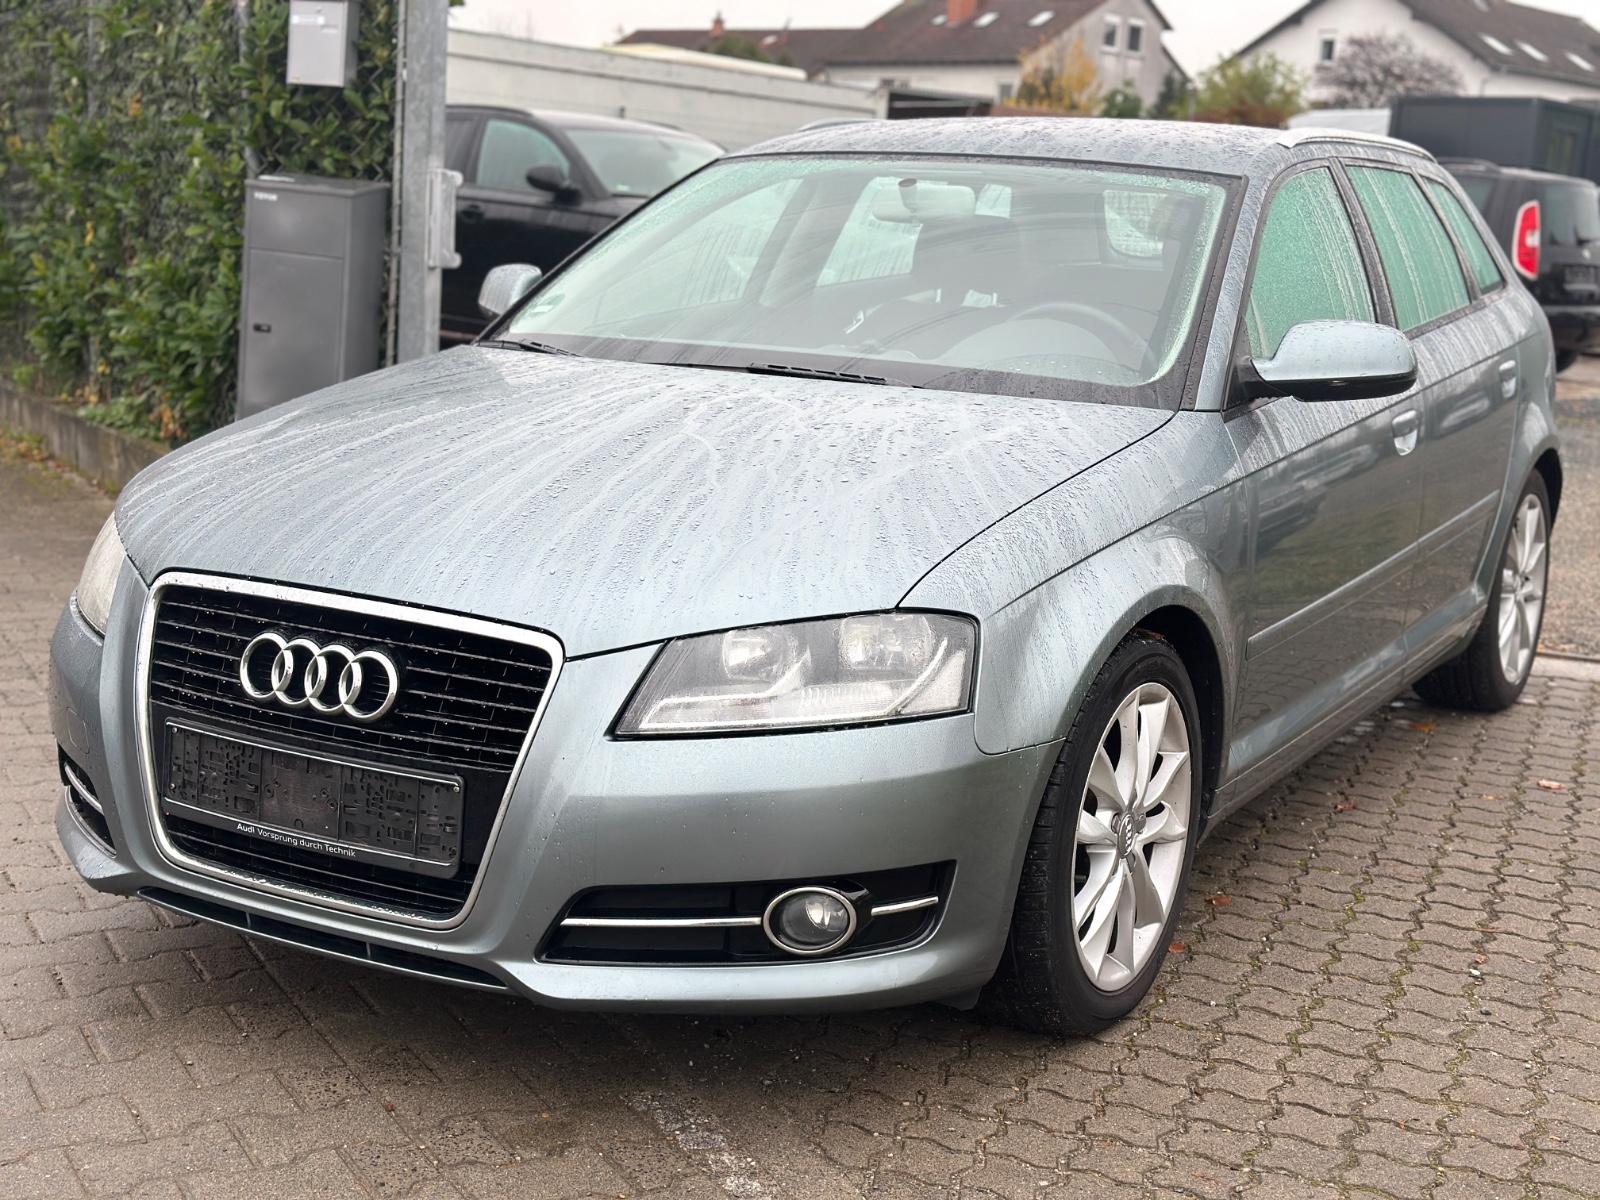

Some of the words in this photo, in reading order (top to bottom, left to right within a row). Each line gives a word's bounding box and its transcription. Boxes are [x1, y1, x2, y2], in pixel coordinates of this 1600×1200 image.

[237, 823, 255, 833] Audi
[258, 828, 298, 846] Vorsprung
[300, 840, 322, 850] durch
[324, 844, 356, 857] Technik
